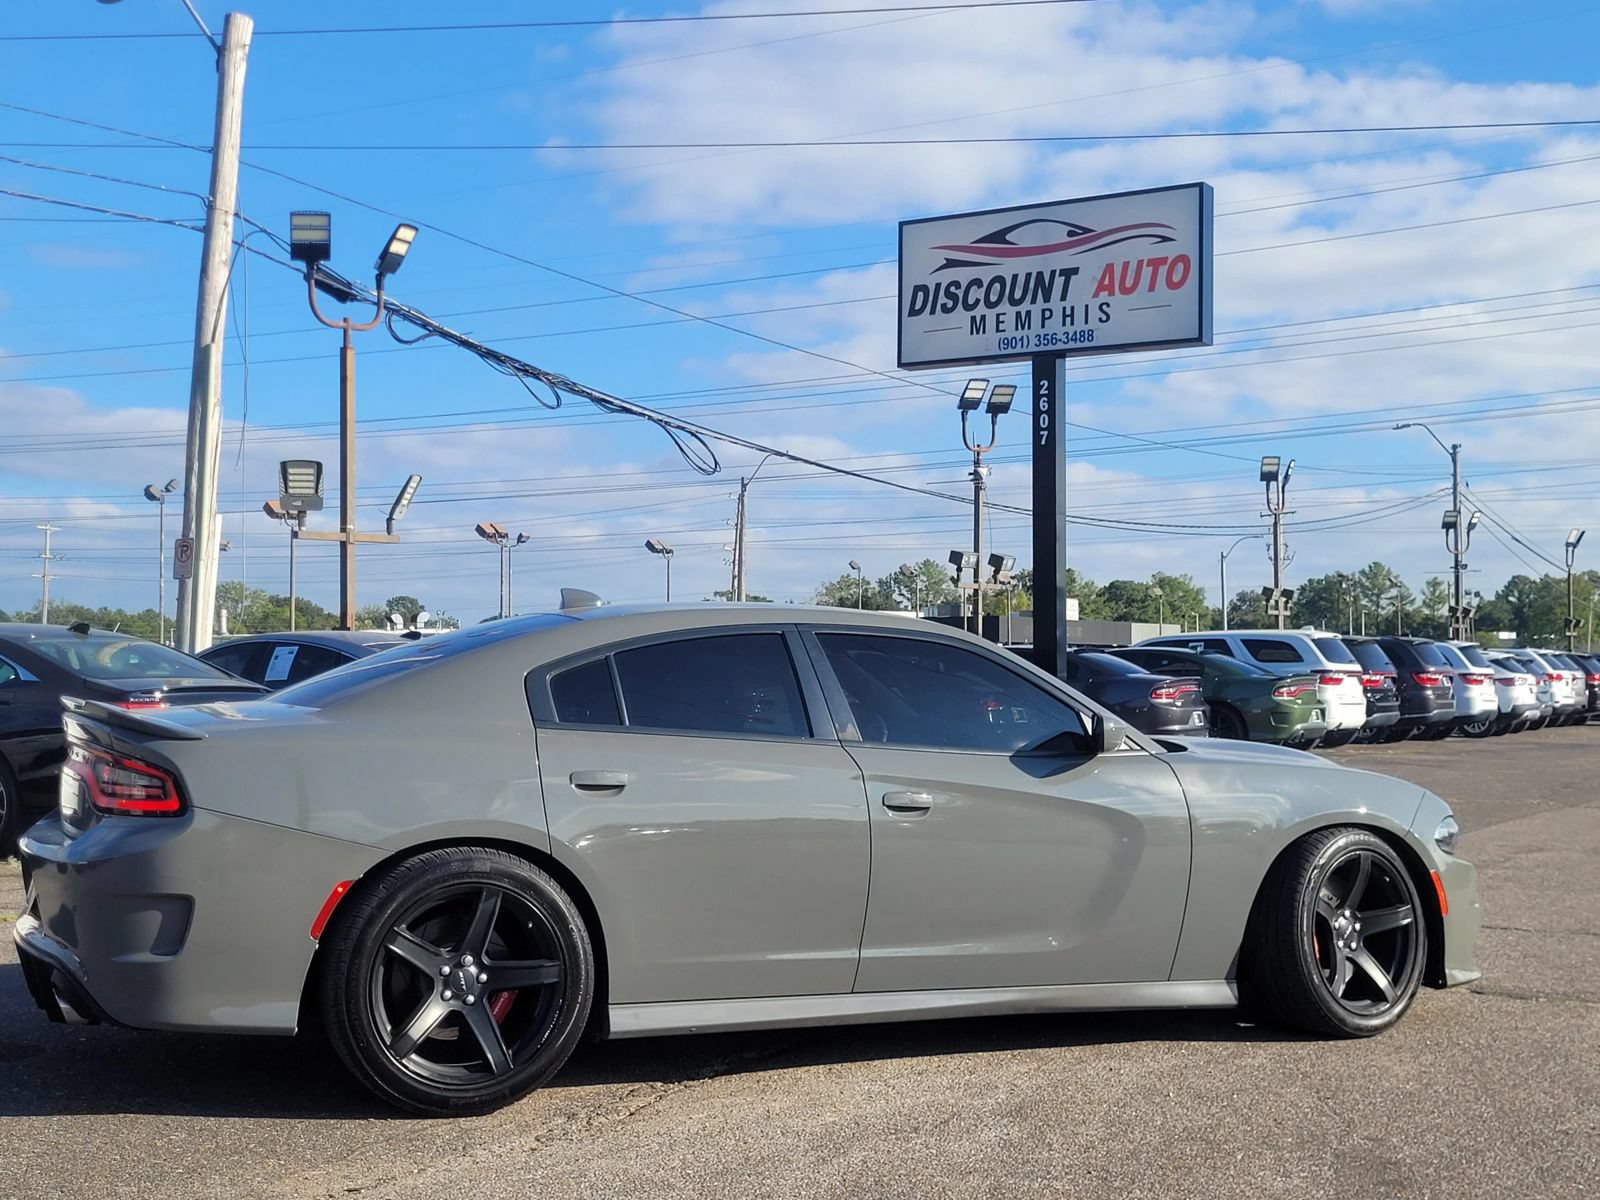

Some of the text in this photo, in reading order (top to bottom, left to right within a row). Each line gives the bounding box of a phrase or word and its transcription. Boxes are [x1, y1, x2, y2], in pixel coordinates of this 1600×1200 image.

[907, 254, 1192, 318] DISCOUNT AUTO
[969, 302, 1112, 336] MEMPHIS
[998, 329, 1095, 351] (901) 356-3488
[1039, 380, 1049, 445] 2607
